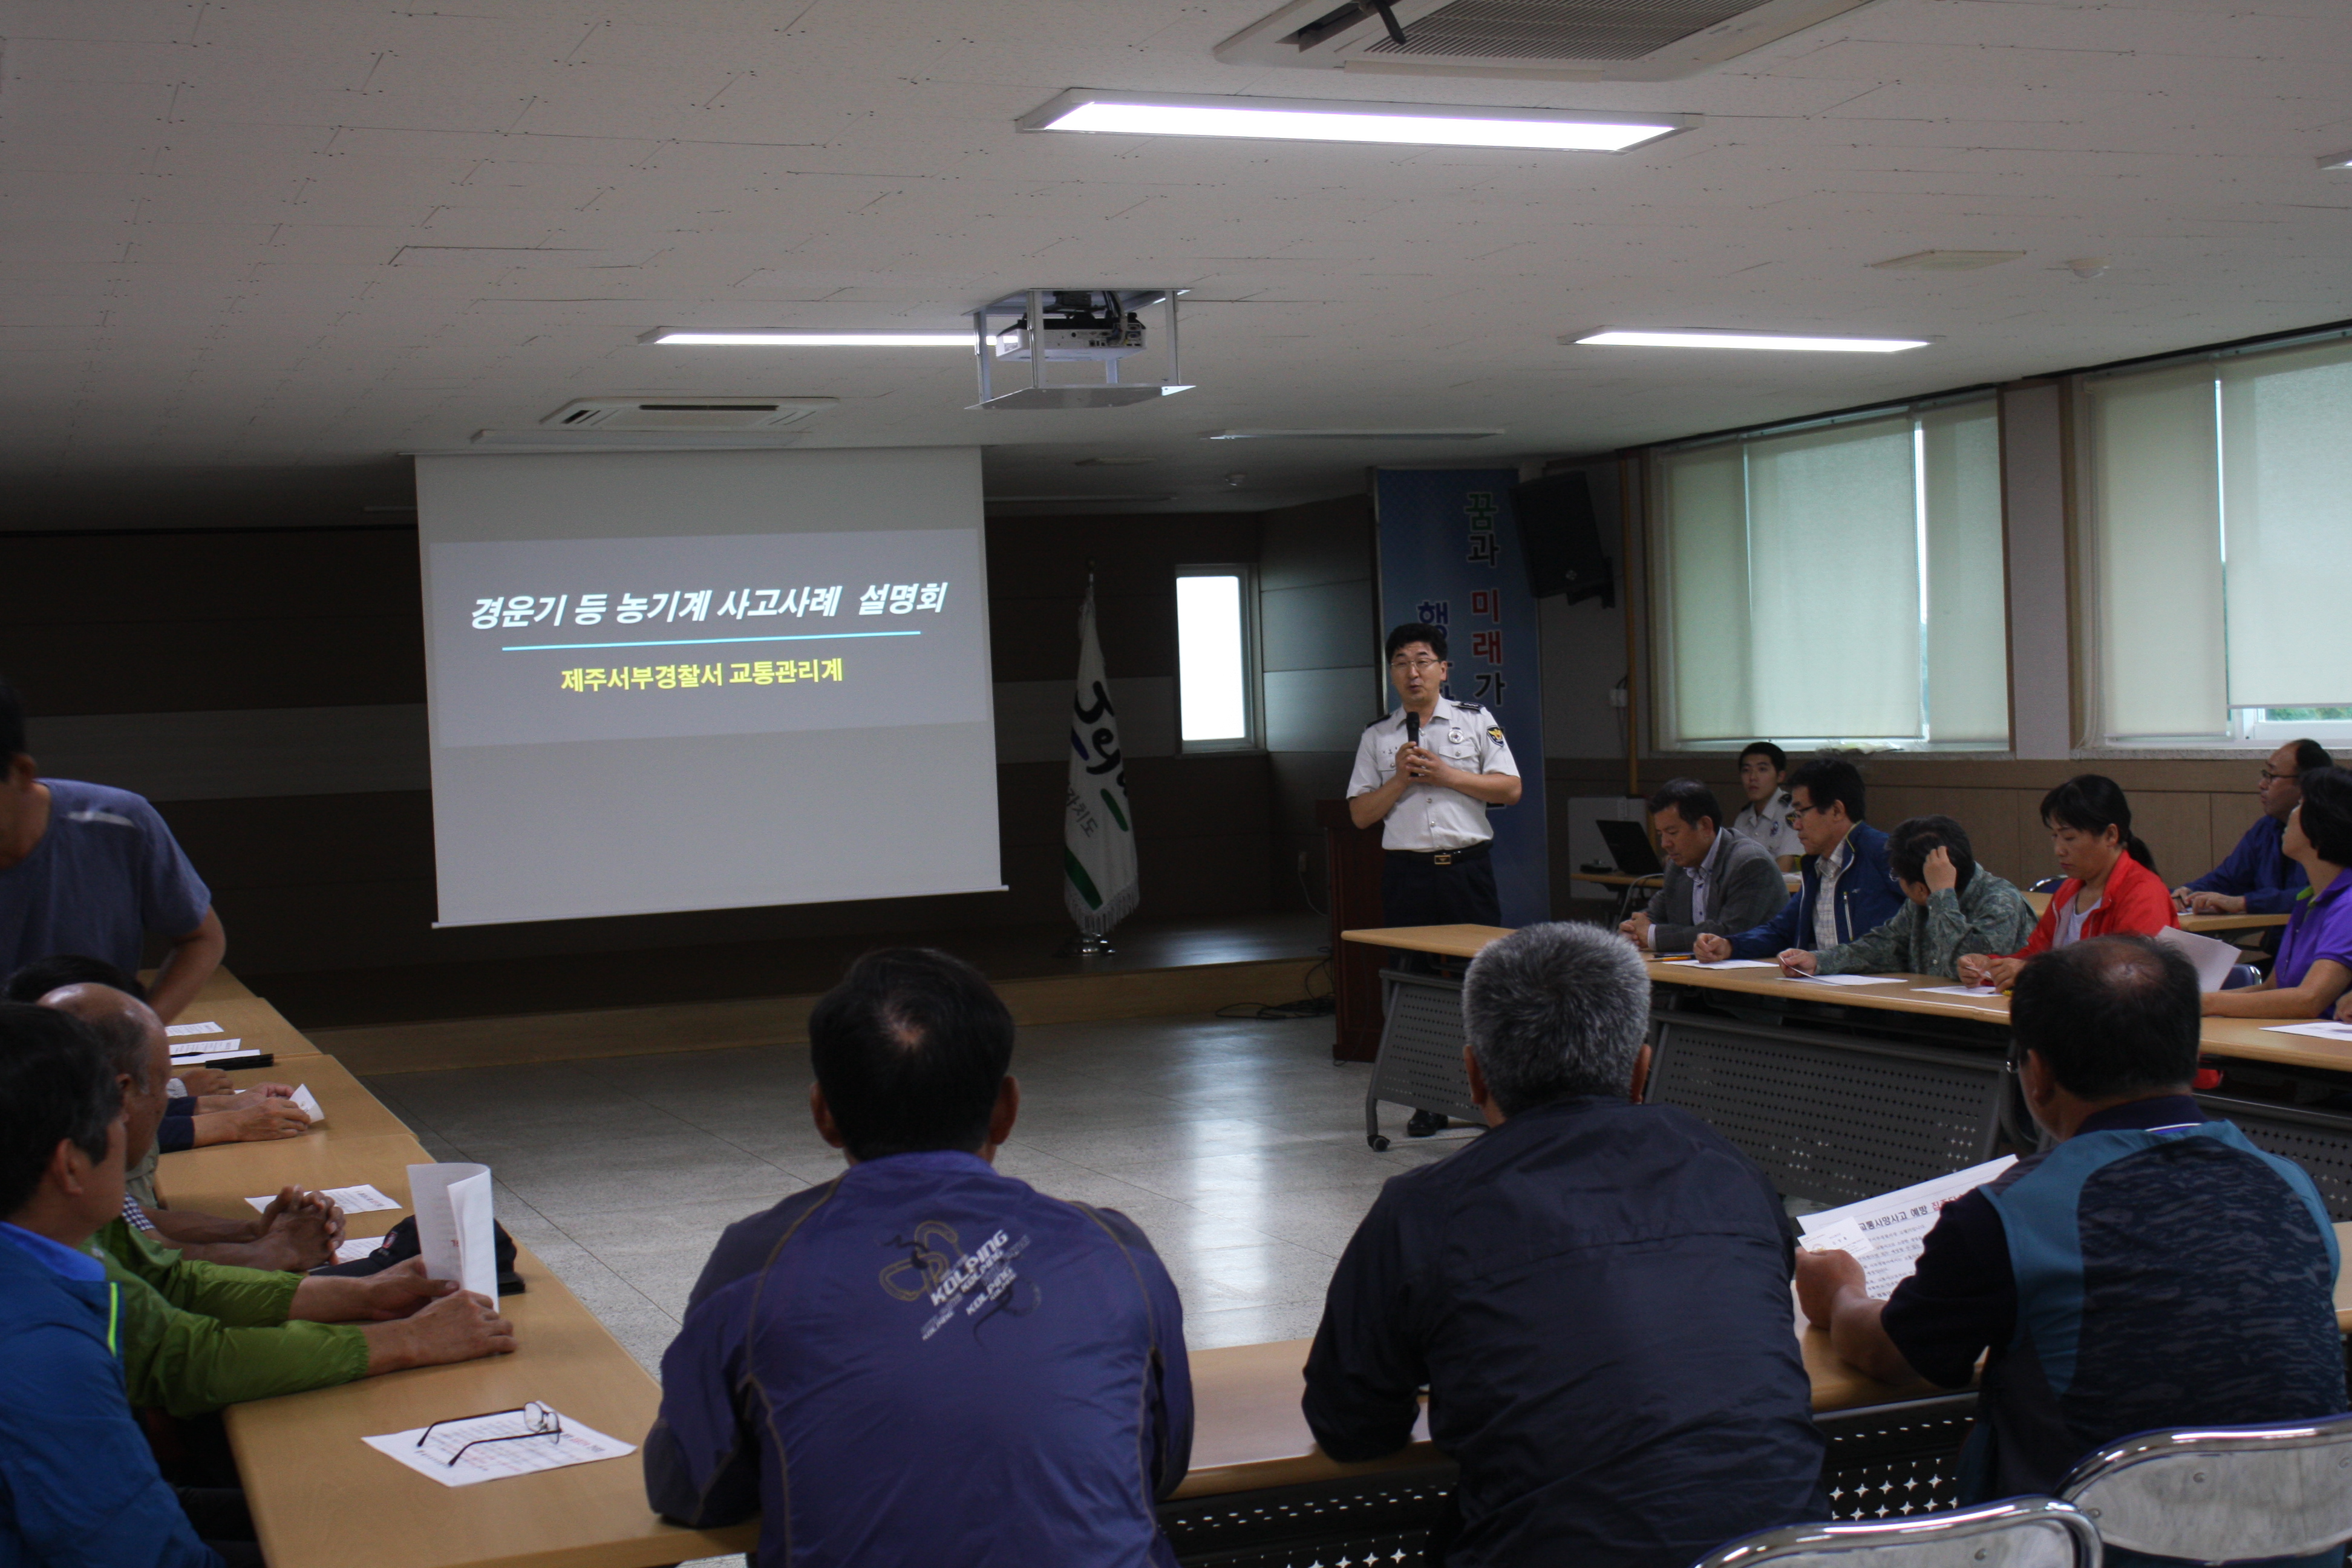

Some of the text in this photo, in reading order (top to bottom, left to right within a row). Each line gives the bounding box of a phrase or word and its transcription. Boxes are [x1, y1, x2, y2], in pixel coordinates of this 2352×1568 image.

[471, 582, 948, 630] 경운기 등 농기계 사고사례 설명회
[1465, 493, 1505, 705] 꿈과 미래가
[560, 658, 843, 692] 제주서부경찰서 교통관리계
[1910, 1205, 1928, 1217] 예방
